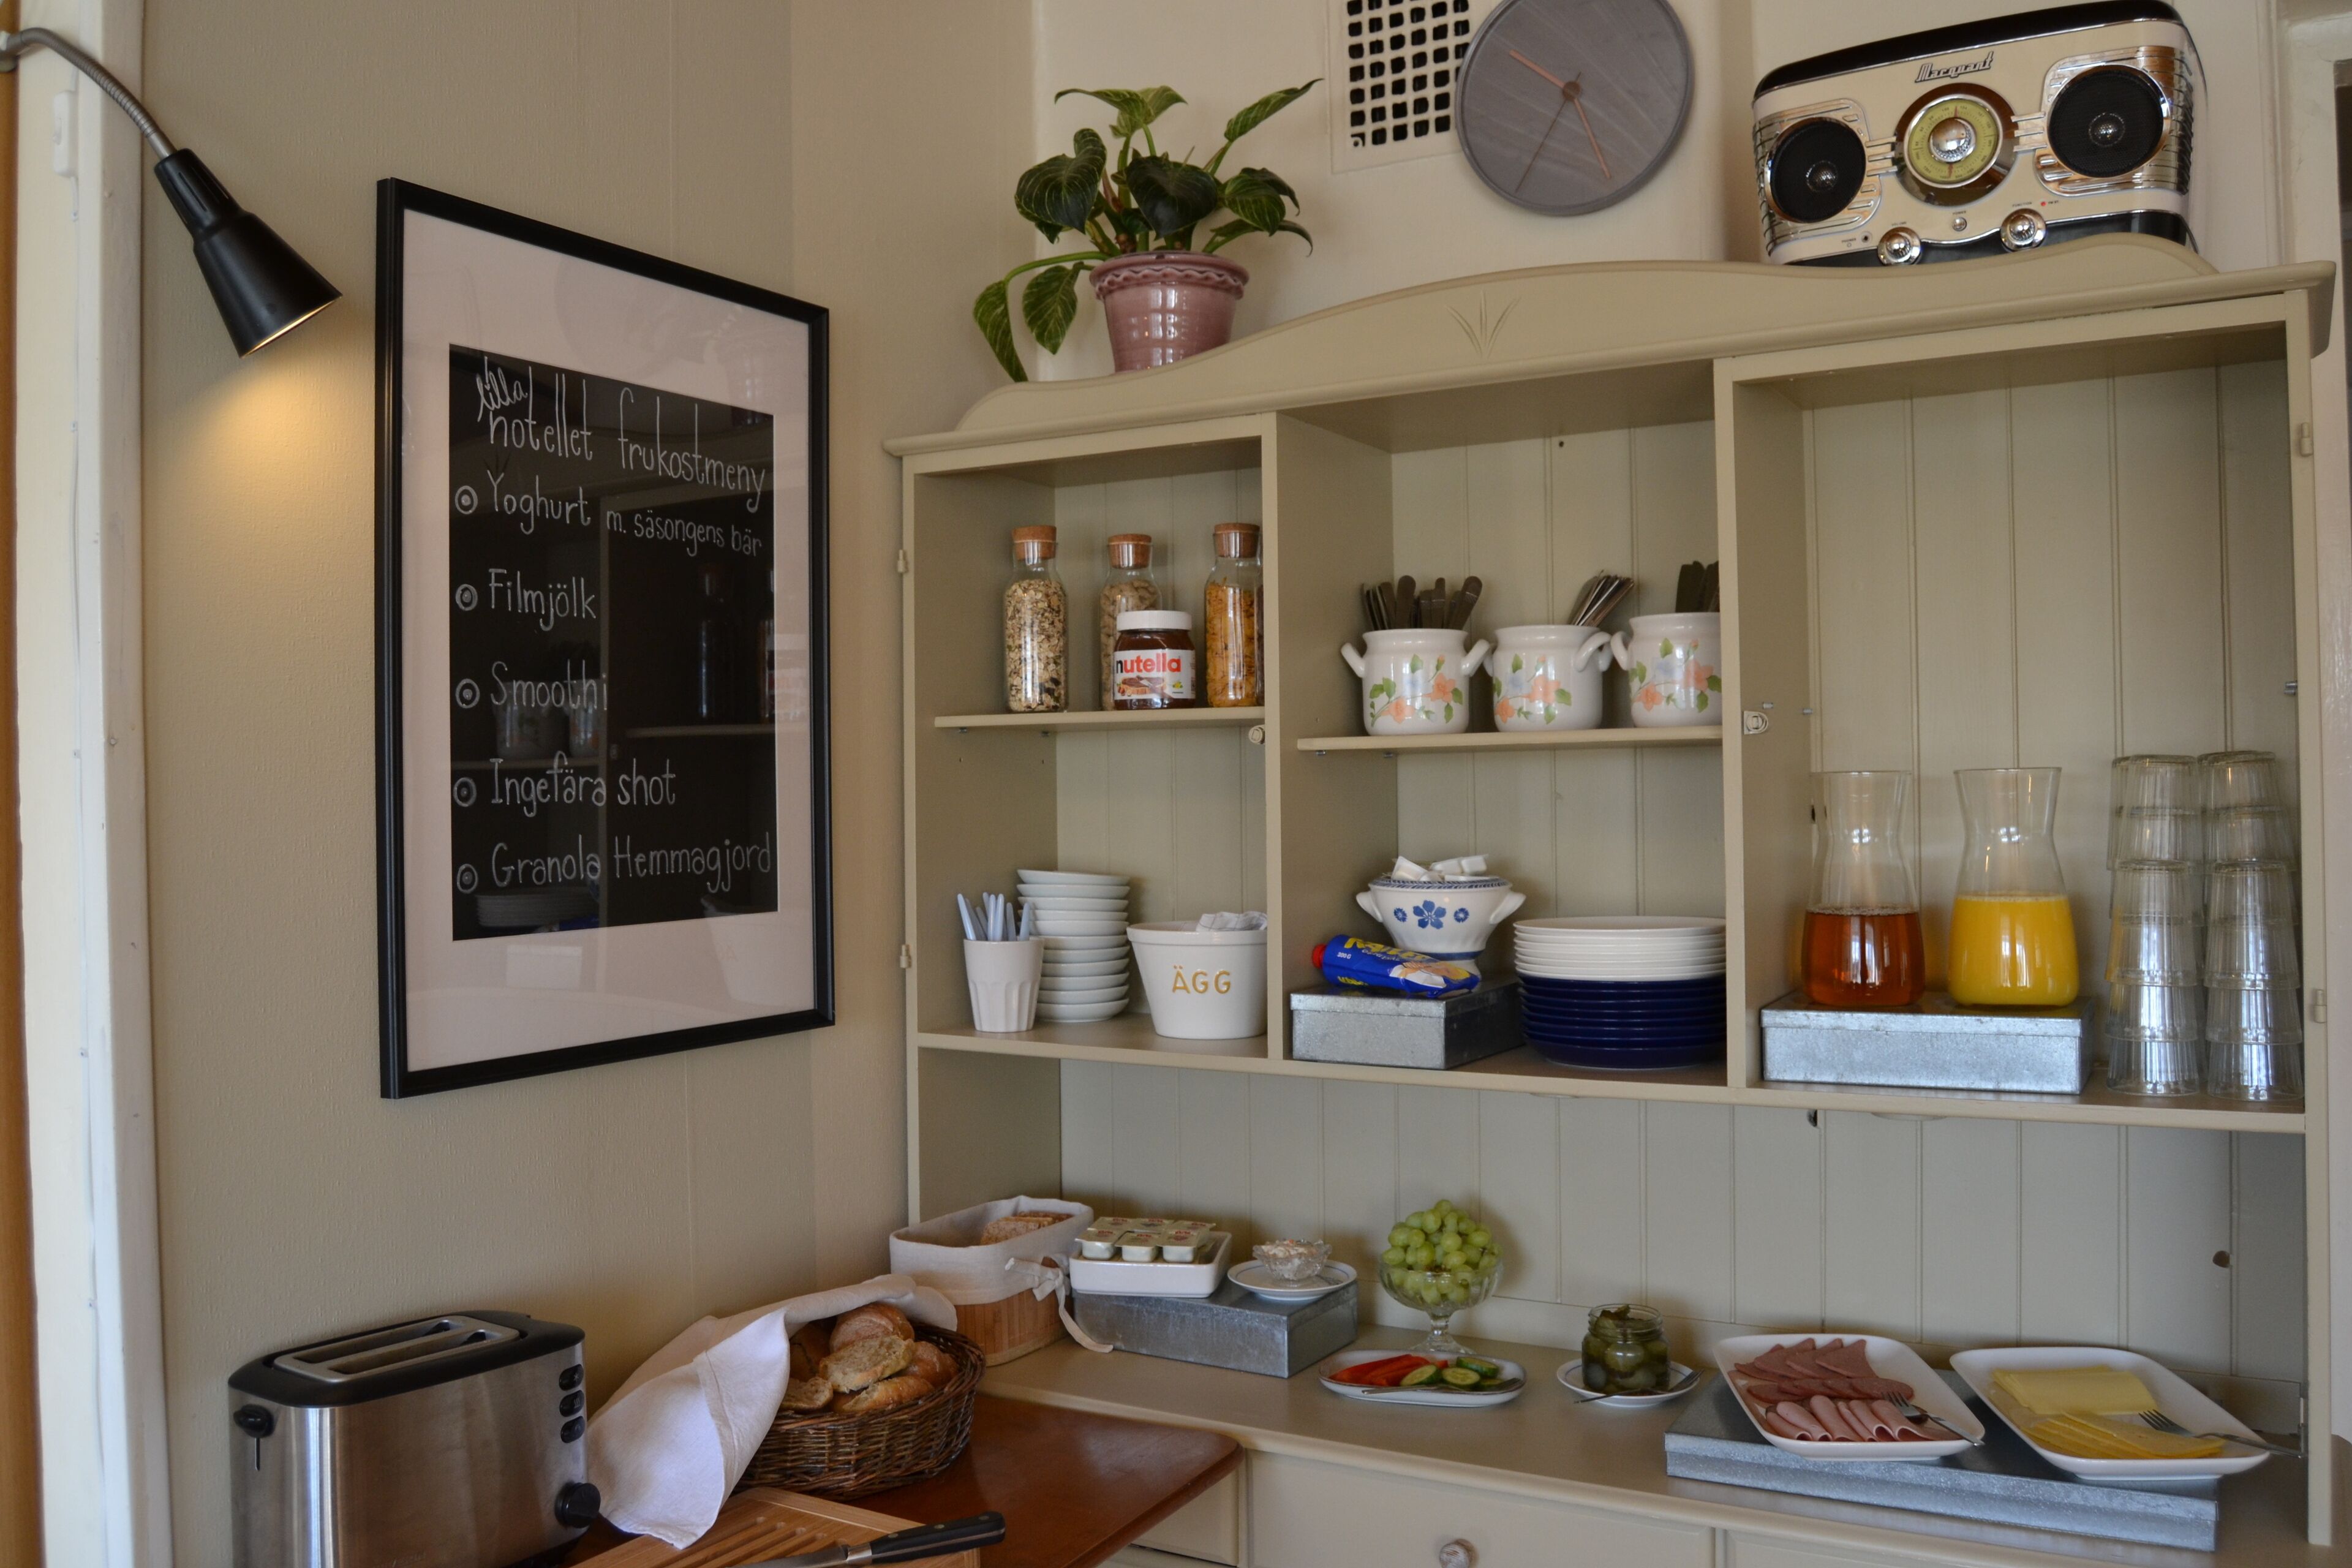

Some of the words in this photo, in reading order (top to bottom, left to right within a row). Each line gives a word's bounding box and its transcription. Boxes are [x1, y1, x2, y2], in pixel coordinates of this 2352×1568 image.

[617, 387, 766, 513] frukostmeny
[487, 469, 592, 535] Yoghurt
[606, 510, 627, 534] m.
[633, 510, 725, 557] säsongens
[731, 524, 763, 557] bär
[488, 567, 597, 631] Filmjölk
[490, 658, 608, 710] Smoothi
[1115, 653, 1182, 674] nutella
[489, 750, 606, 818] Ingefära
[617, 758, 676, 805] shot
[491, 834, 601, 888] Granola
[613, 831, 771, 894] Hemmagjord
[1172, 965, 1231, 994] ÄGG
